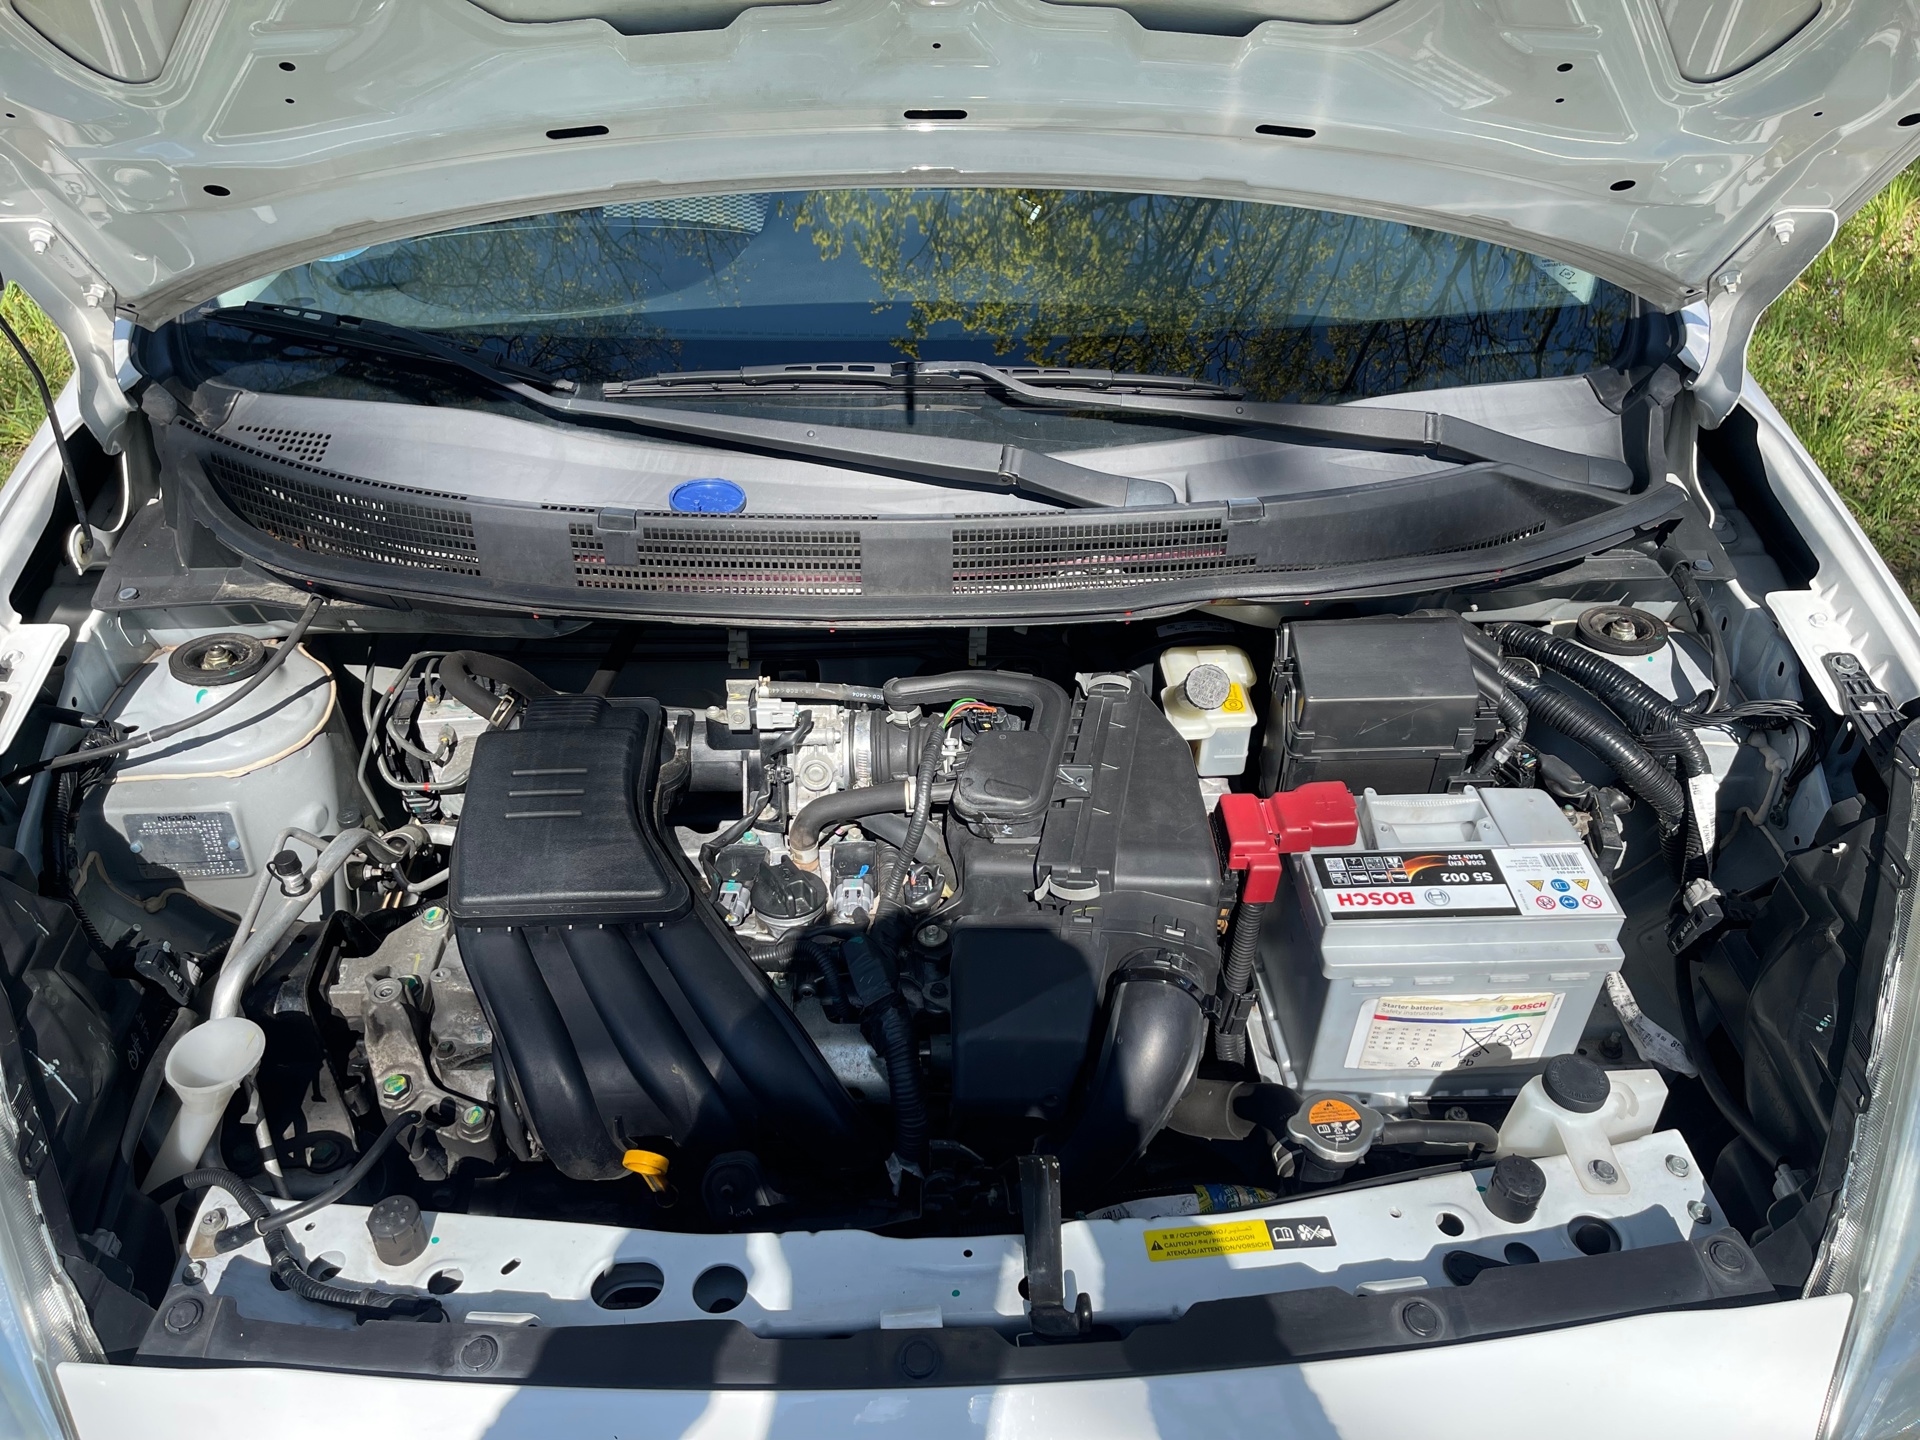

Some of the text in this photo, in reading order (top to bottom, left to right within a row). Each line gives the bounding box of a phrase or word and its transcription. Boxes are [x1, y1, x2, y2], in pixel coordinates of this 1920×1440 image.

[1440, 871, 1494, 882] S5 002
[1337, 891, 1415, 907] BOSCH
[1382, 1002, 1409, 1010] Starter
[1511, 1001, 1547, 1011] BOSCH
[1381, 1008, 1402, 1016] Safety
[1164, 1240, 1194, 1248] CAUTION
